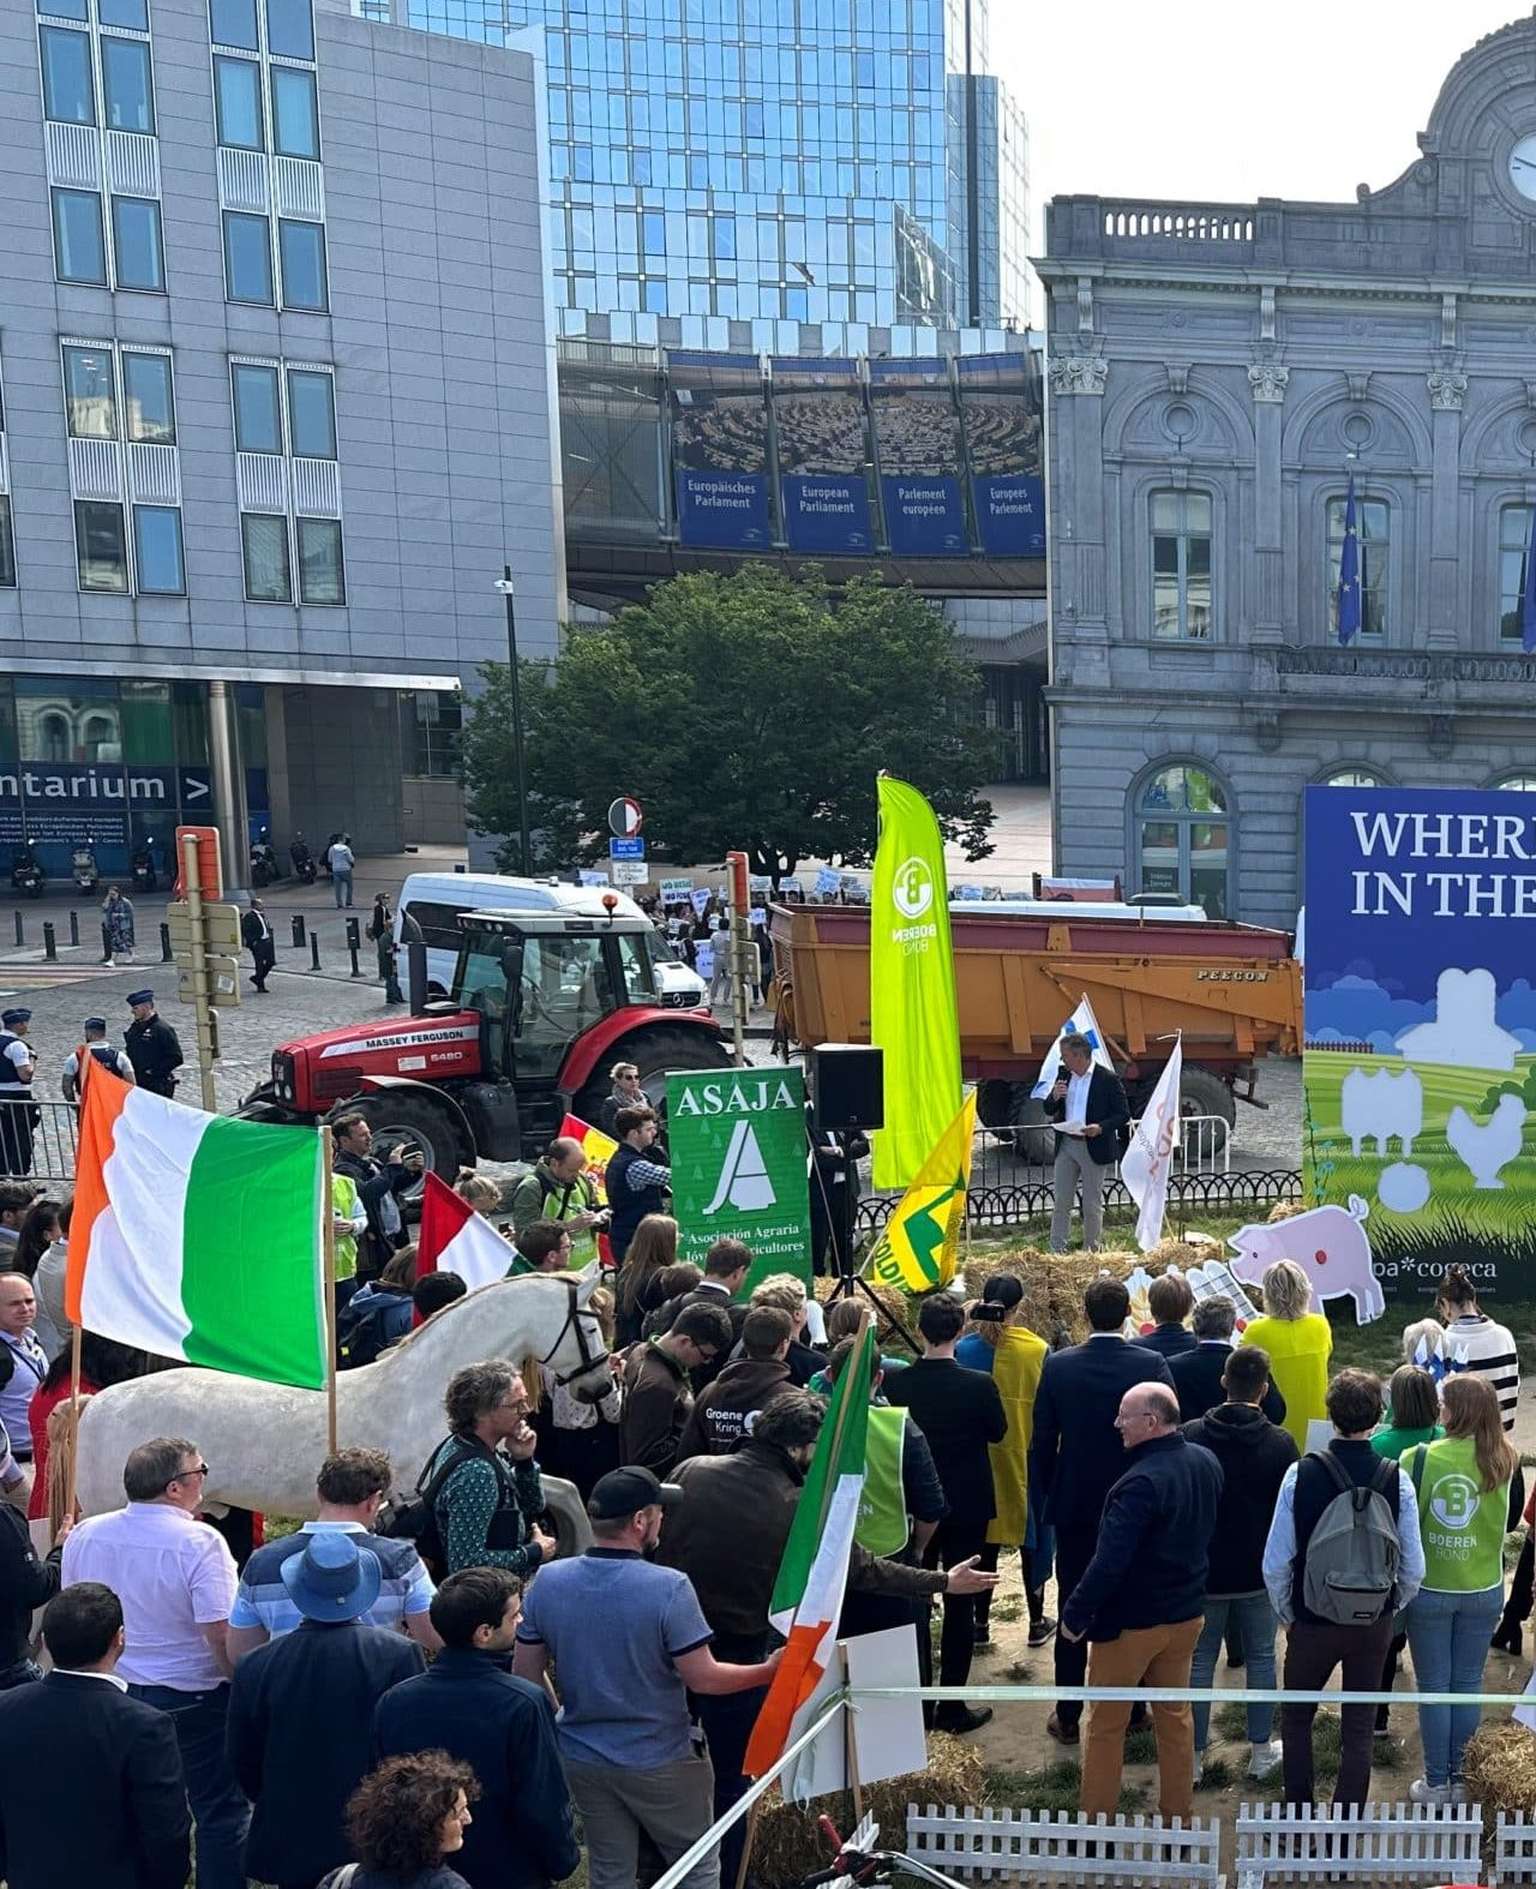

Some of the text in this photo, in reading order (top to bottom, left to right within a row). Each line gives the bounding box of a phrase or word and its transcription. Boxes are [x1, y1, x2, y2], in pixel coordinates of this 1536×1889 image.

[688, 479, 756, 495] Europäisches
[802, 485, 849, 499] European
[899, 487, 946, 500] Parlement
[990, 487, 1028, 501] Europees
[695, 495, 751, 509] Parlament
[800, 500, 855, 513] Parliament
[990, 502, 1033, 515] Parlement
[0, 769, 165, 799] ntarium
[1352, 871, 1417, 916] IN
[366, 1030, 464, 1048] MASSEY FERGUSON
[674, 1080, 798, 1117] ASAJA
[755, 1223, 799, 1240] Agraria
[750, 1241, 805, 1256] ricultores
[706, 1407, 743, 1421] Groene
[715, 1421, 742, 1434] Kring
[1428, 1532, 1478, 1548] BOEREN
